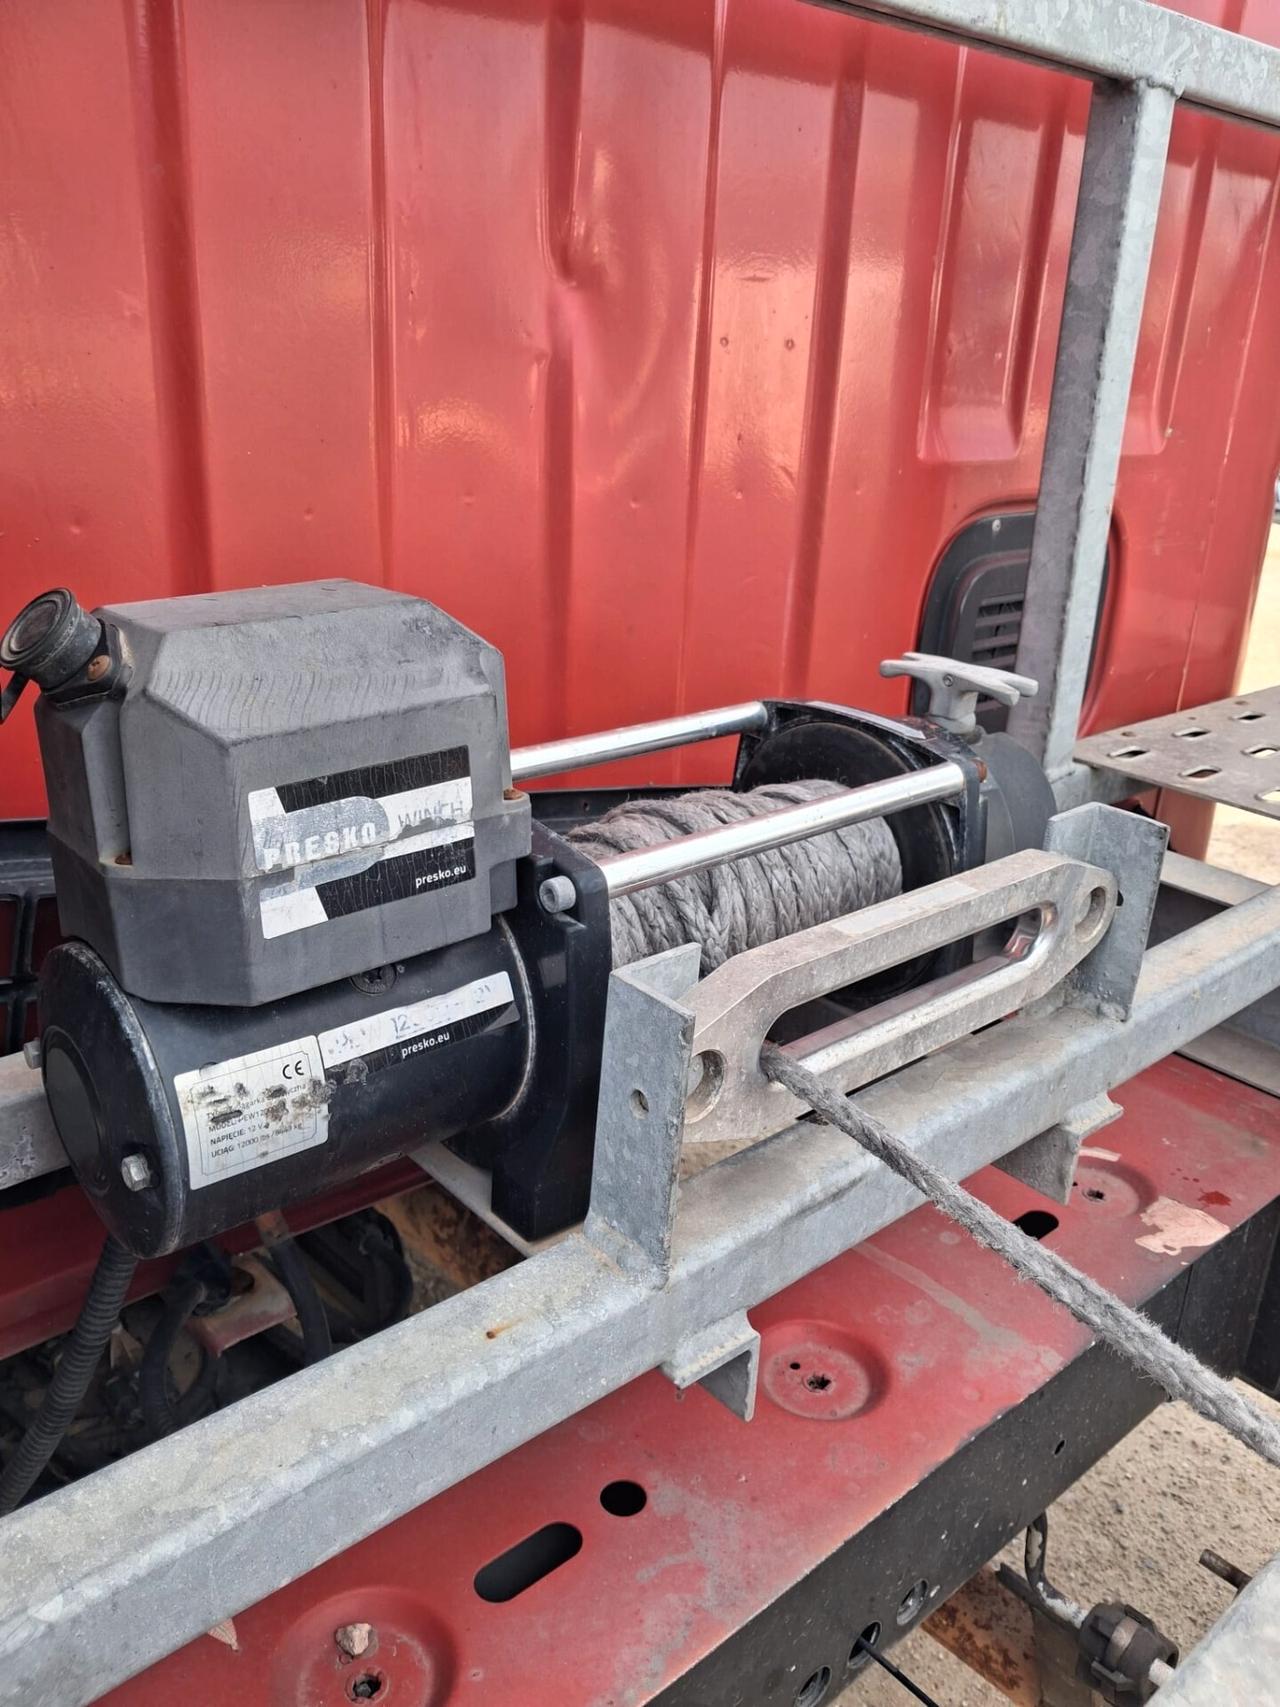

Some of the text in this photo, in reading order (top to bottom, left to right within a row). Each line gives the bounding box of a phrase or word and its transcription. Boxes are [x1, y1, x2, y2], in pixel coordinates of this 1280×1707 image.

[263, 822, 375, 871] PRESKO
[415, 864, 467, 888] presko.eu
[401, 1031, 450, 1059] presko.eu
